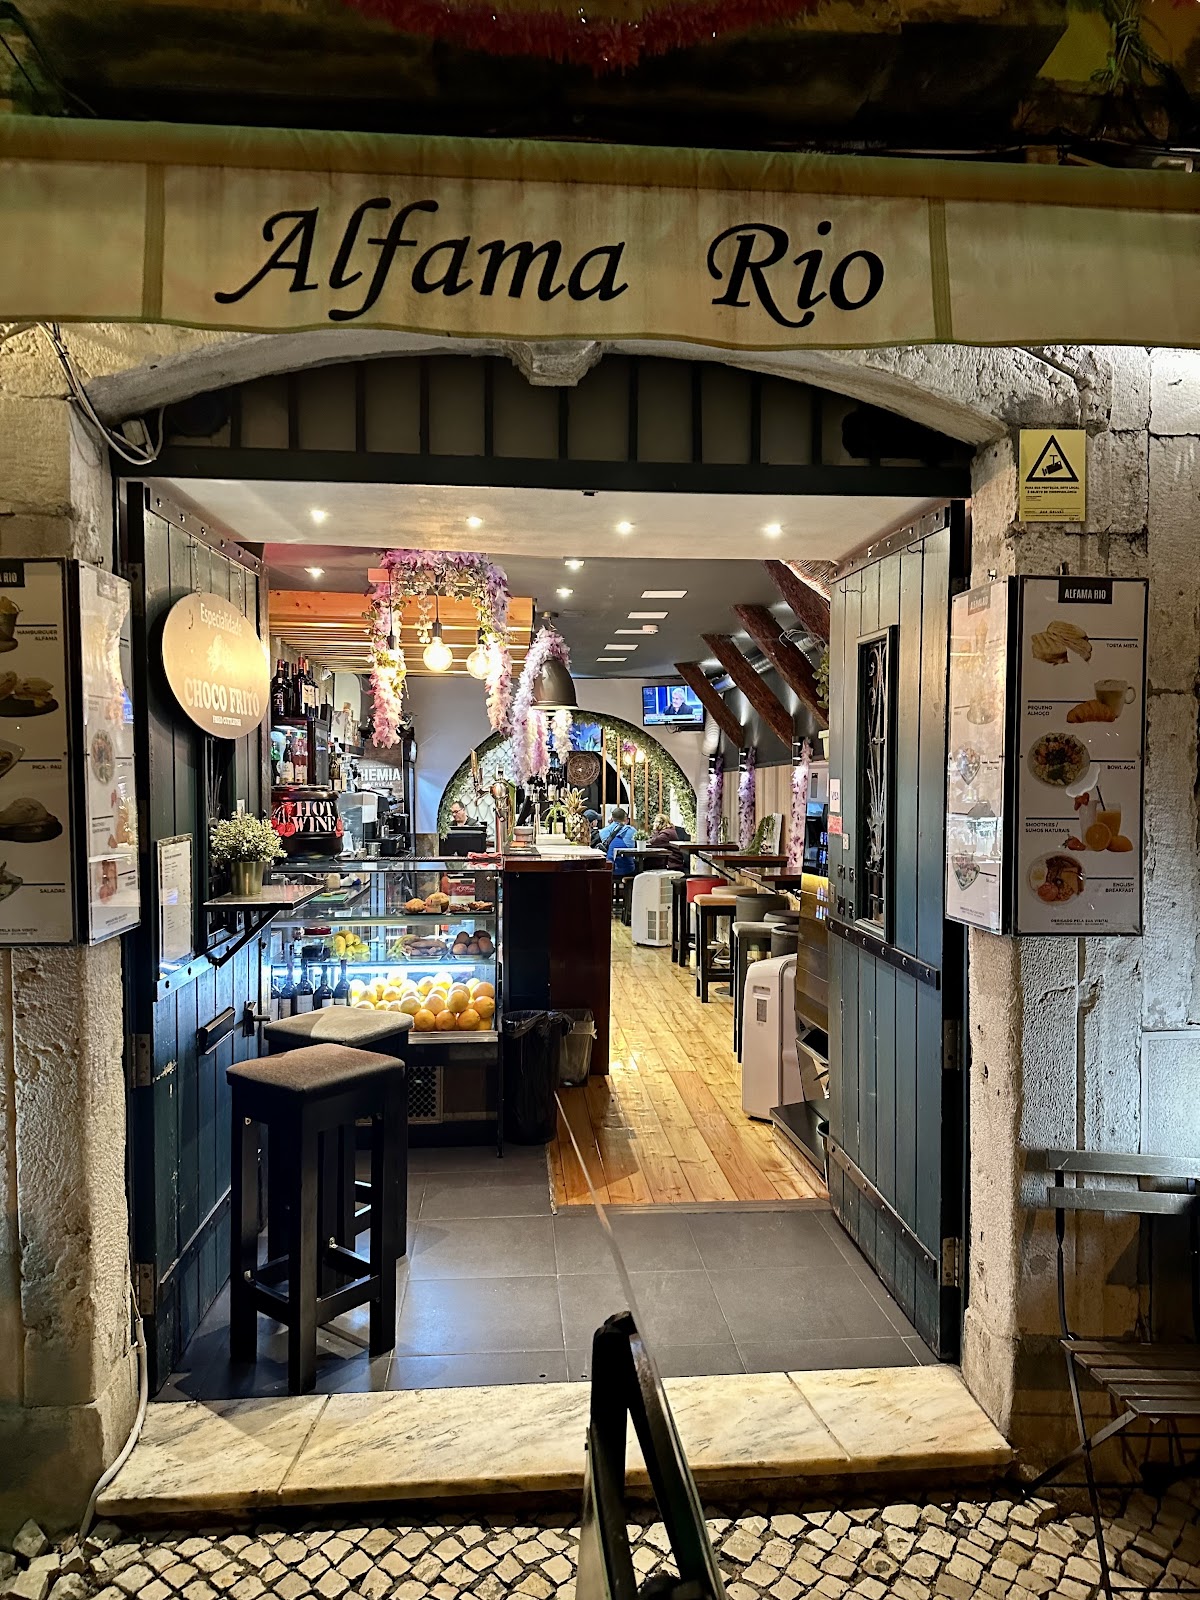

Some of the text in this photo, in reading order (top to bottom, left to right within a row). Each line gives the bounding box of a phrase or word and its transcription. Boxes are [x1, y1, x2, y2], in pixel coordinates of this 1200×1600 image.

[214, 197, 885, 329] Alfama Rio
[3, 572, 18, 583] RIO
[1064, 588, 1107, 600] ALFAMA RIO
[200, 602, 242, 637] Especialidade
[184, 677, 227, 712] CHOCO
[229, 687, 260, 717] FRITO
[359, 767, 401, 781] HEMIA
[295, 801, 334, 817] HOT
[290, 816, 337, 832] WINE
